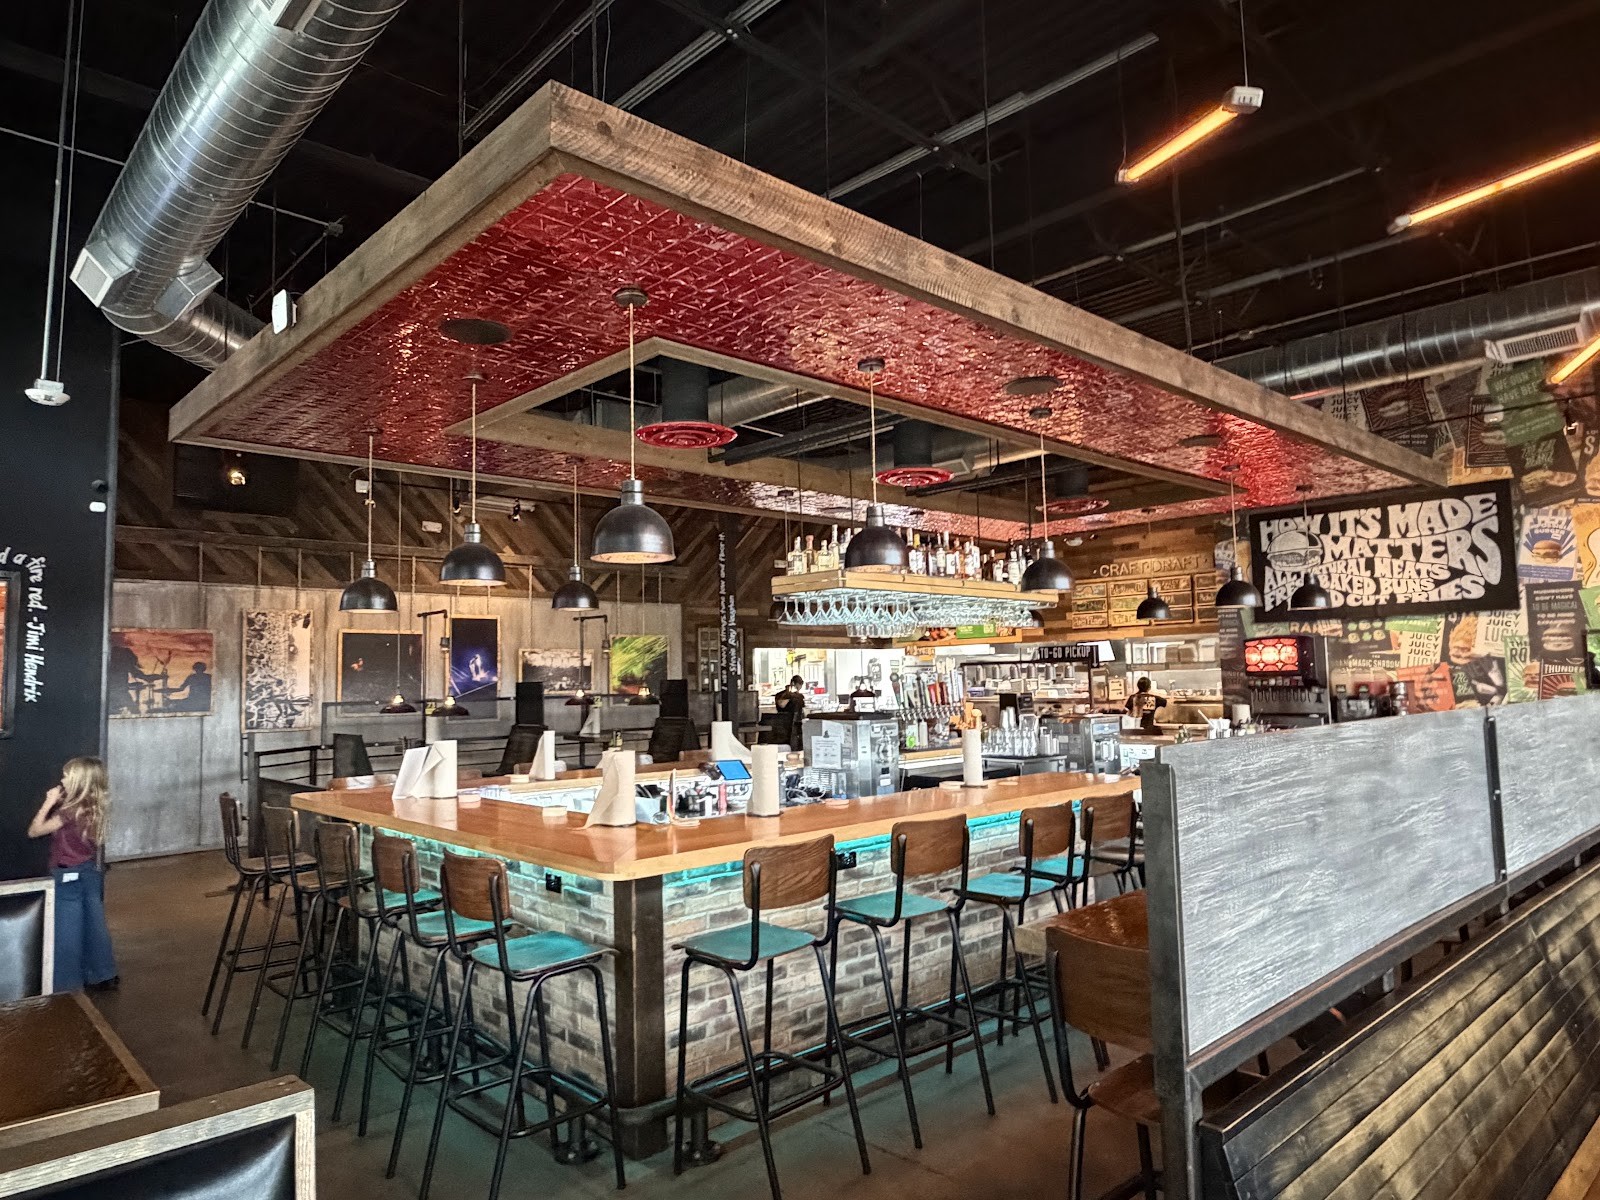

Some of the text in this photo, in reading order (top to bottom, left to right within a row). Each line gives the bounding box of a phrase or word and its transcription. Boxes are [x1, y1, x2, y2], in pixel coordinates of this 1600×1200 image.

[1387, 492, 1498, 539] MADE
[1319, 515, 1502, 585] MATTERS
[1373, 556, 1451, 580] MEATS
[1317, 573, 1377, 596] BAKED
[1379, 577, 1436, 596] BUNS
[1396, 574, 1486, 604] FRIES
[12, 553, 29, 566] a
[23, 653, 45, 703] Hendrix
[1487, 619, 1519, 628] JUICY
[1408, 641, 1439, 649] JUICY
[1410, 633, 1440, 642] JUICY
[1040, 645, 1091, 659] TO-GO PICKUP
[1408, 648, 1438, 657] JUICY
